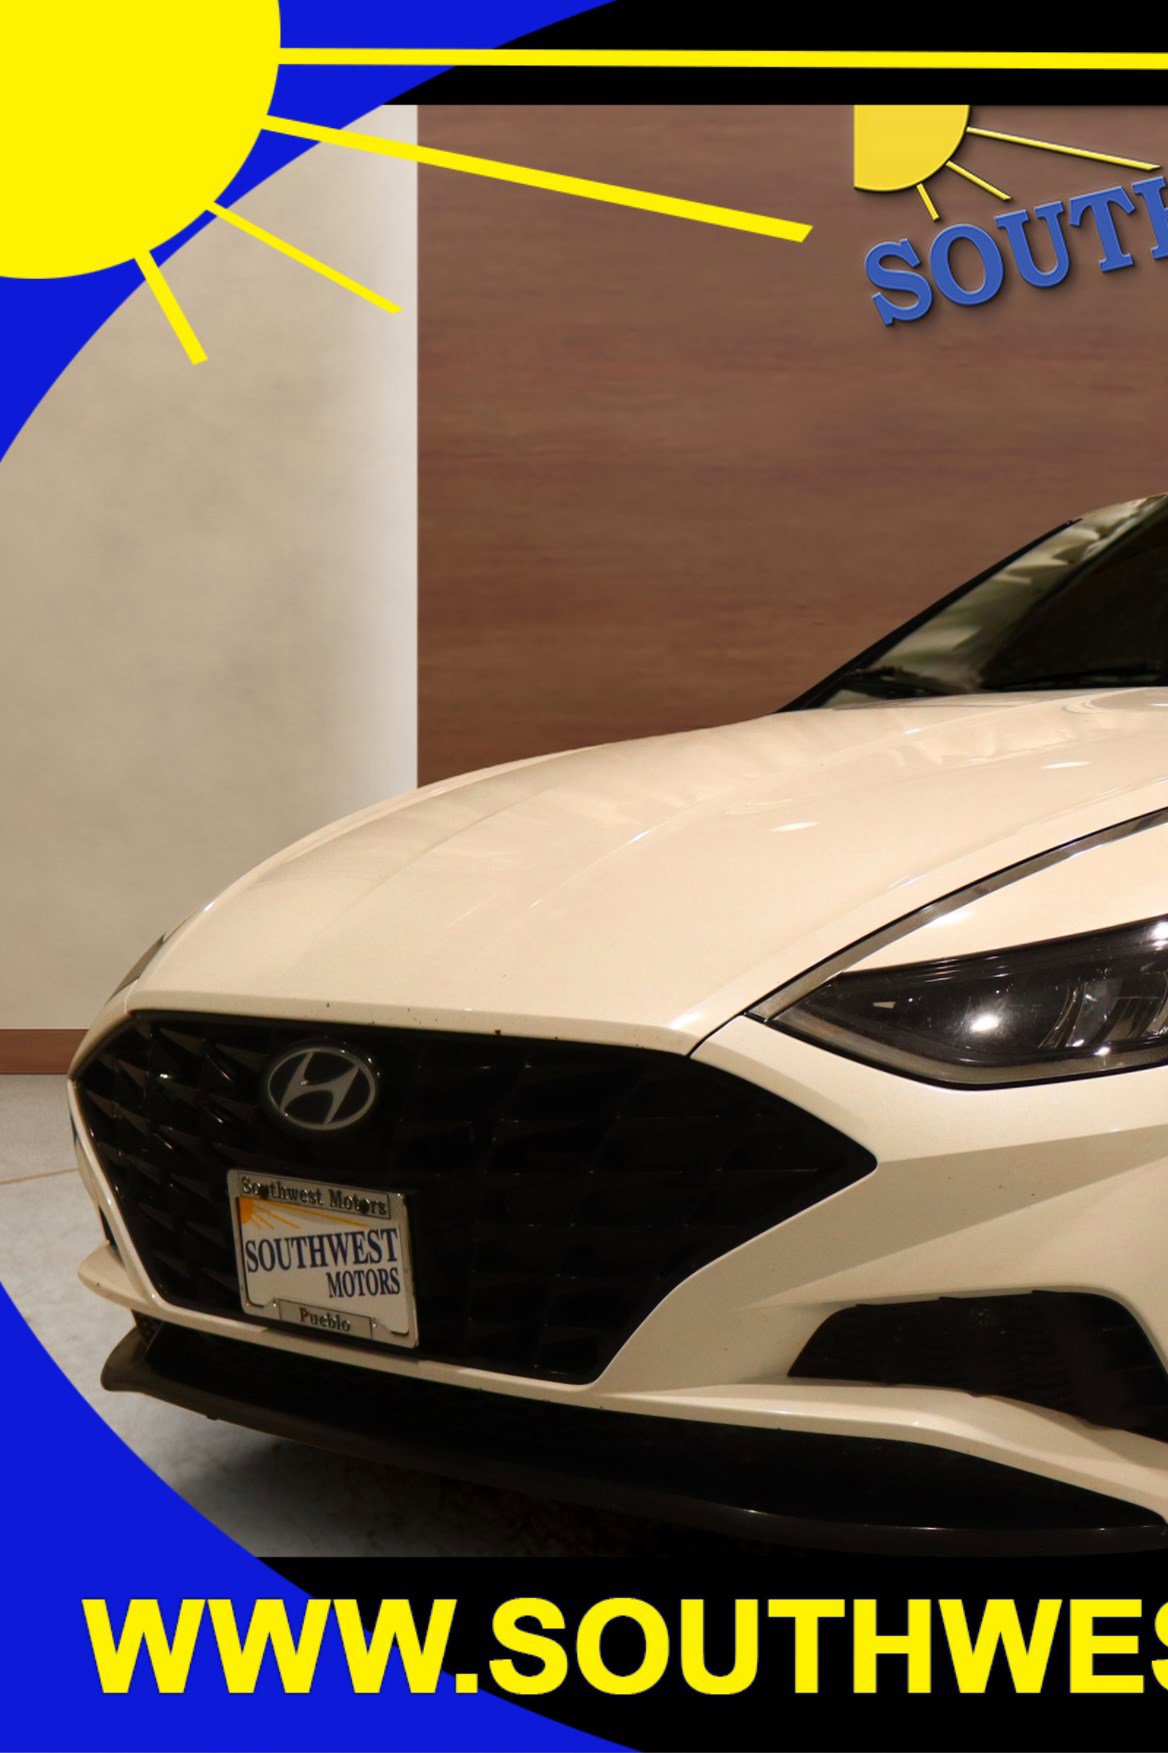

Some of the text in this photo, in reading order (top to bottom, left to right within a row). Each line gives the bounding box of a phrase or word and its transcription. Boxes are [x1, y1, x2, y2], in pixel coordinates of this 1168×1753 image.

[328, 1189, 387, 1215] Motrs
[245, 1228, 398, 1273] SOUTHWEST
[326, 1267, 400, 1298] MOTORS
[299, 1308, 351, 1332] Pueblo
